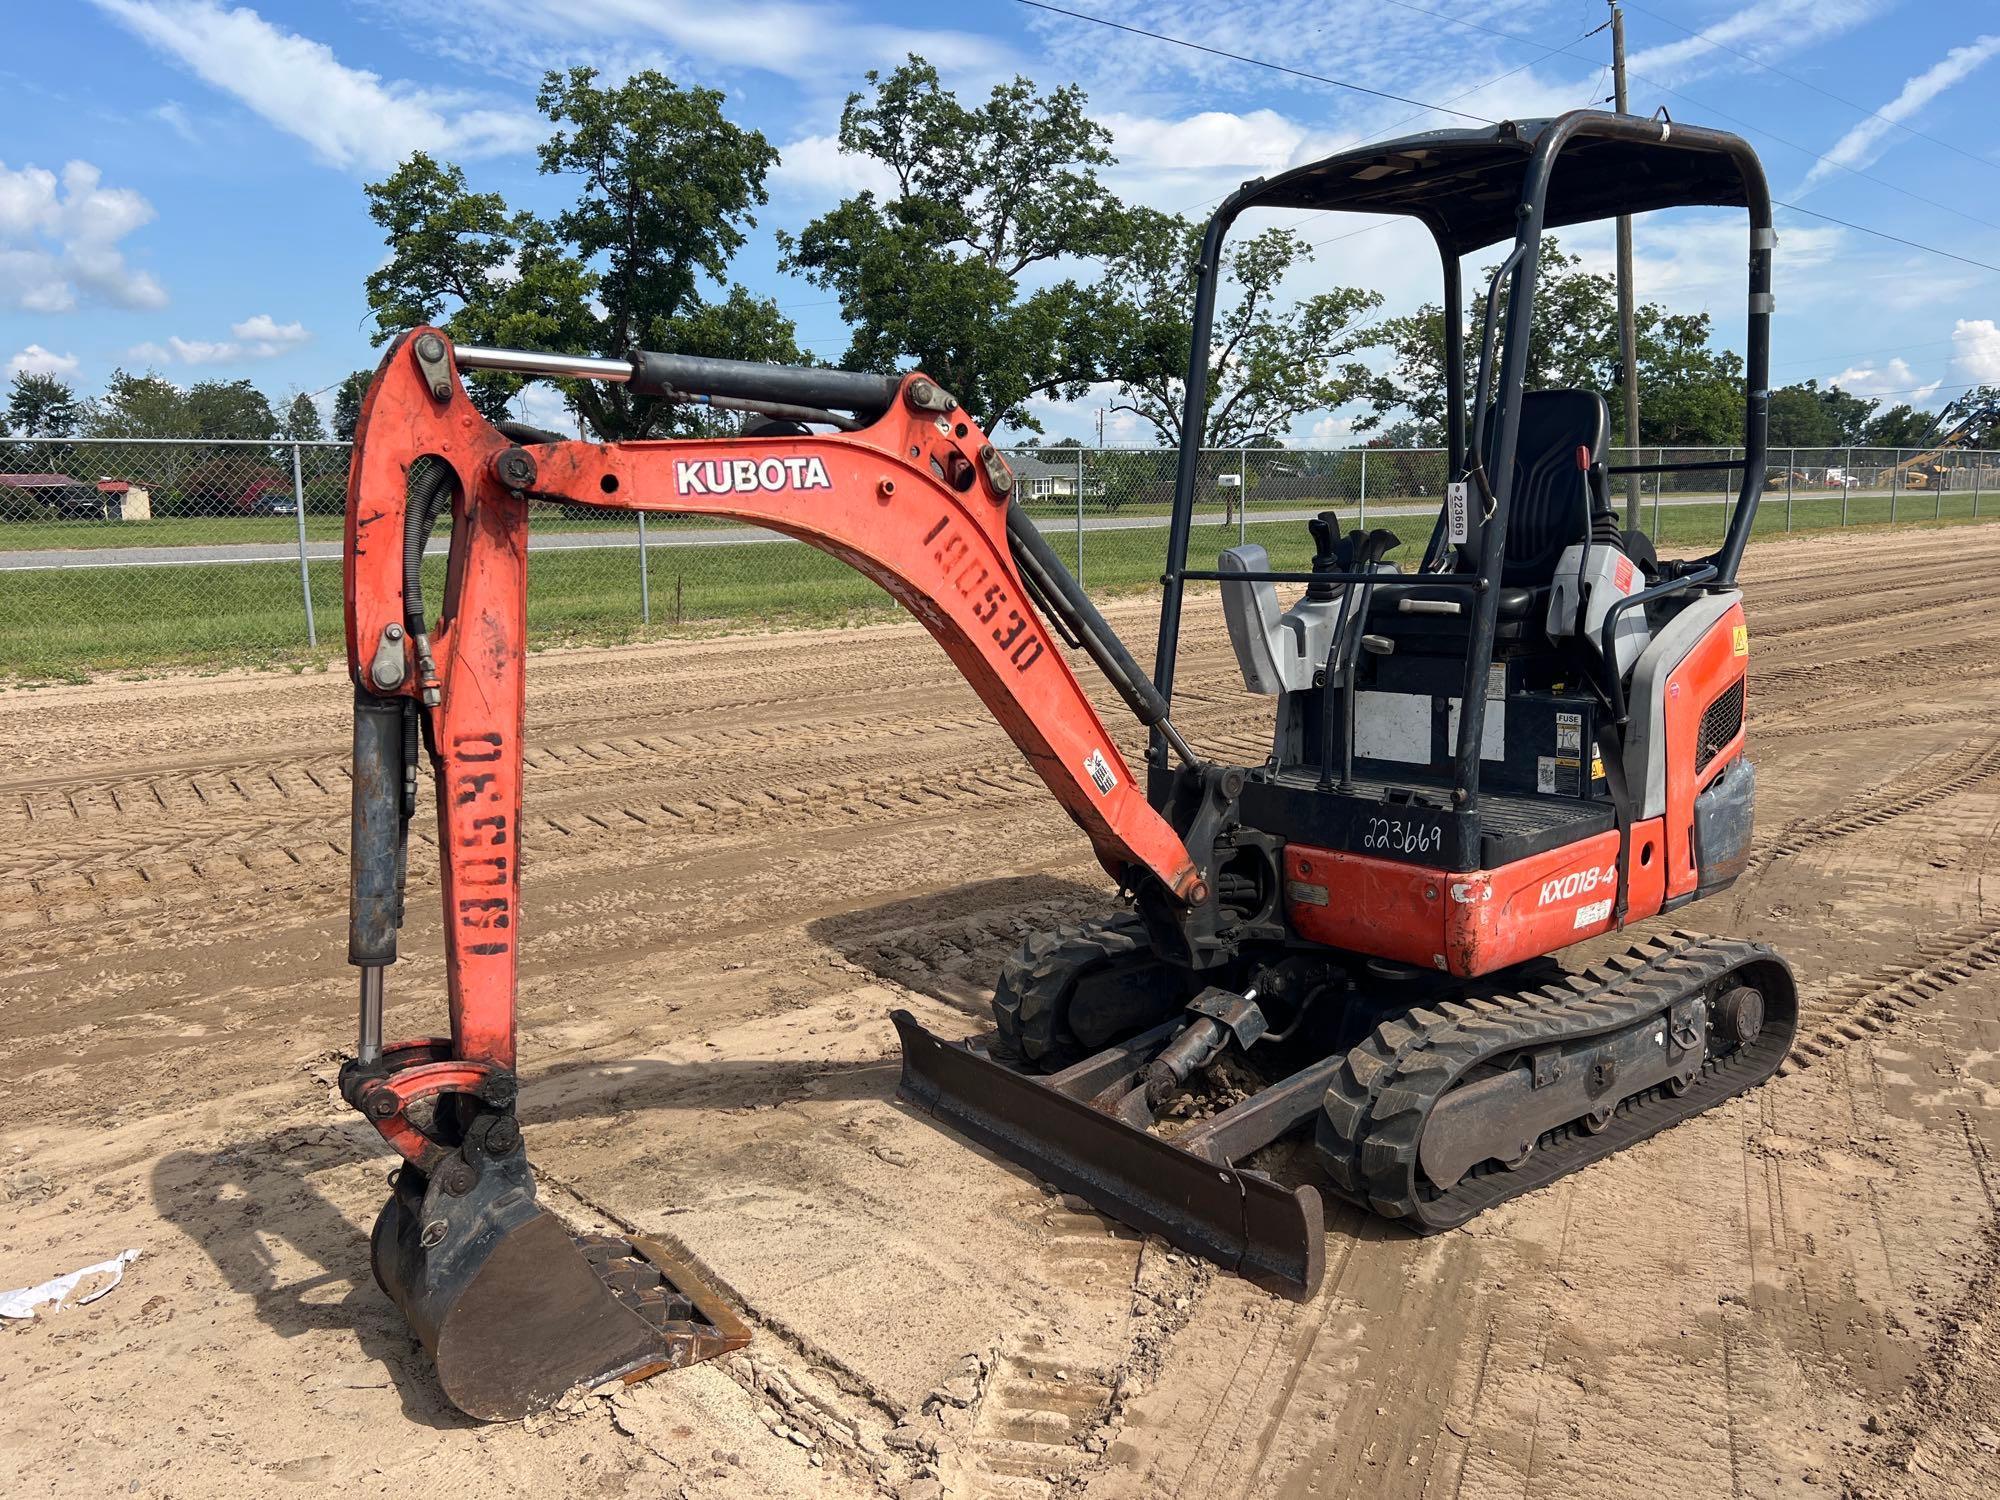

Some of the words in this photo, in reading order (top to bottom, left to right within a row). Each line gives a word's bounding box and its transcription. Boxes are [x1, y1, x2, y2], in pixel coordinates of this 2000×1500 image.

[676, 457, 832, 495] KUBOTA
[1453, 495, 1464, 536] 223669
[1558, 714, 1580, 723] FUSE
[1364, 817, 1442, 854] 223669
[1538, 864, 1616, 907] KX018-4
